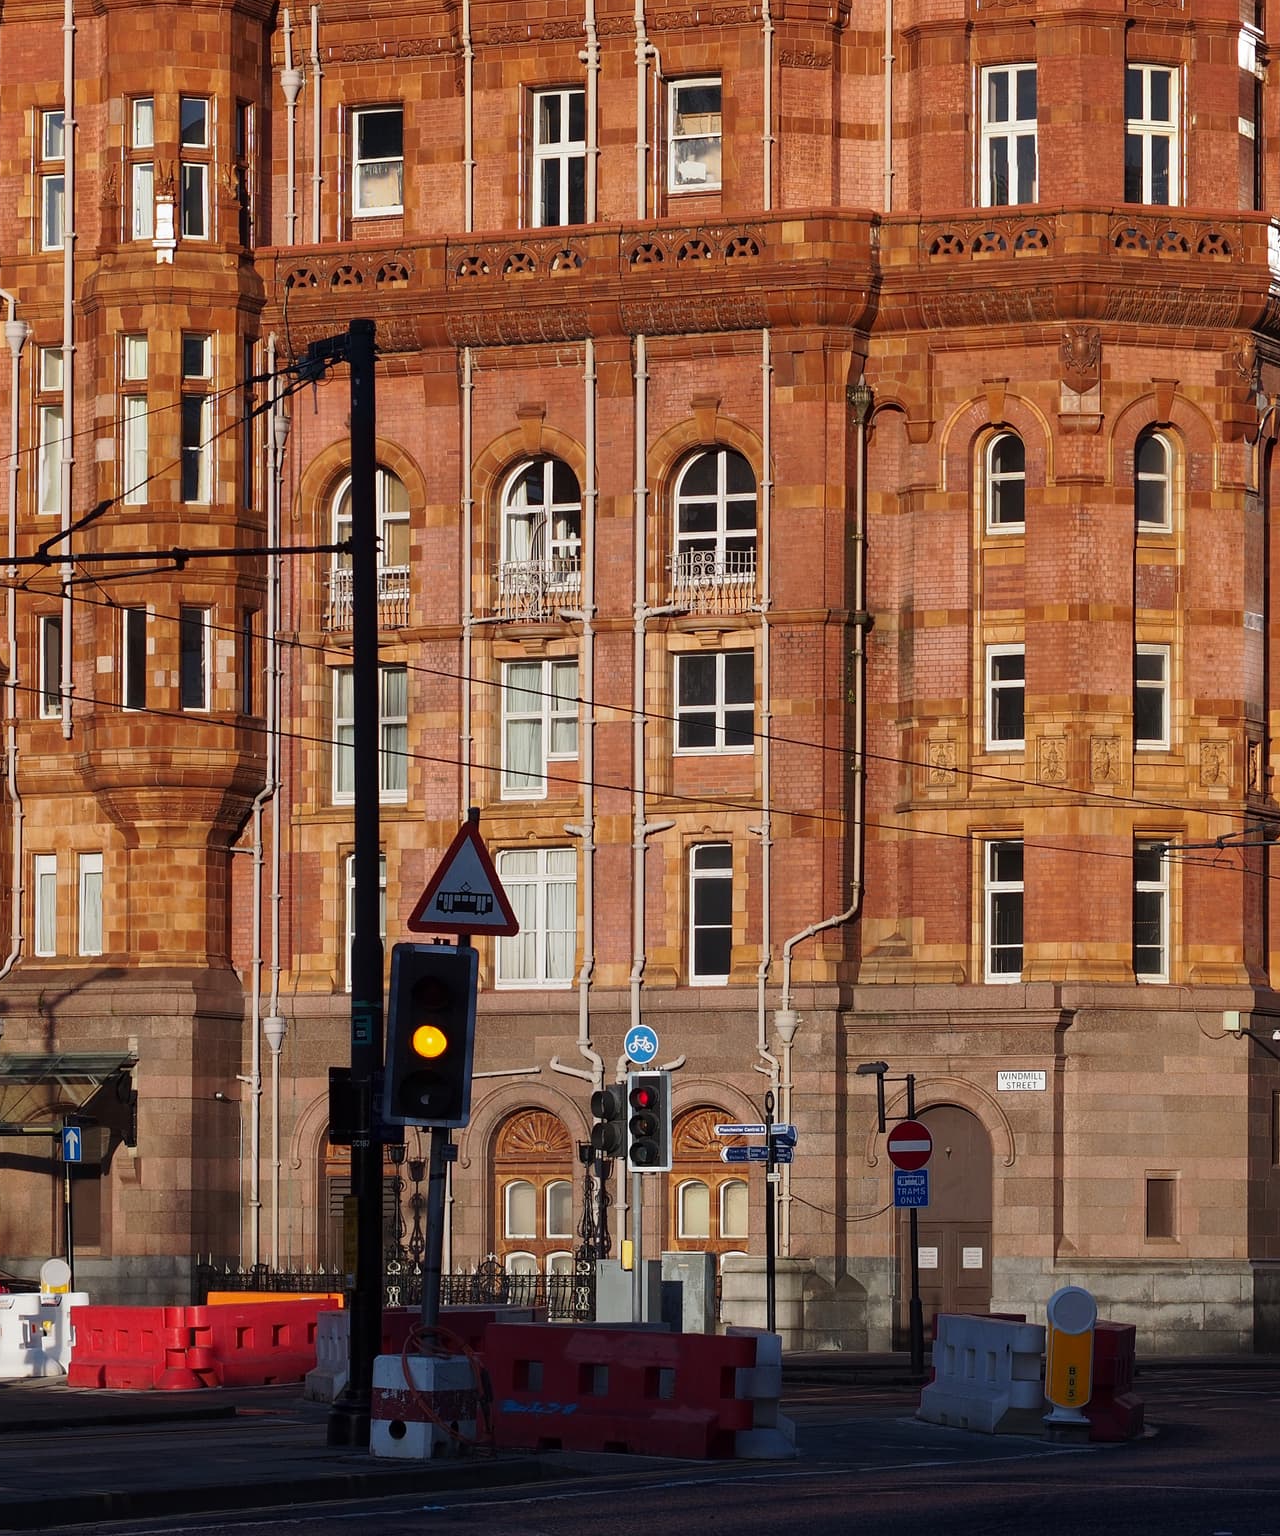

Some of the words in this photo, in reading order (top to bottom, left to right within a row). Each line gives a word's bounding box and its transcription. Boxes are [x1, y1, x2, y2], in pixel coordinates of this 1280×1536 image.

[1000, 1072, 1043, 1080] WINDMILL
[1006, 1081, 1037, 1089] STREET
[897, 1187, 926, 1195] TRAMS
[900, 1196, 922, 1204] ONLY
